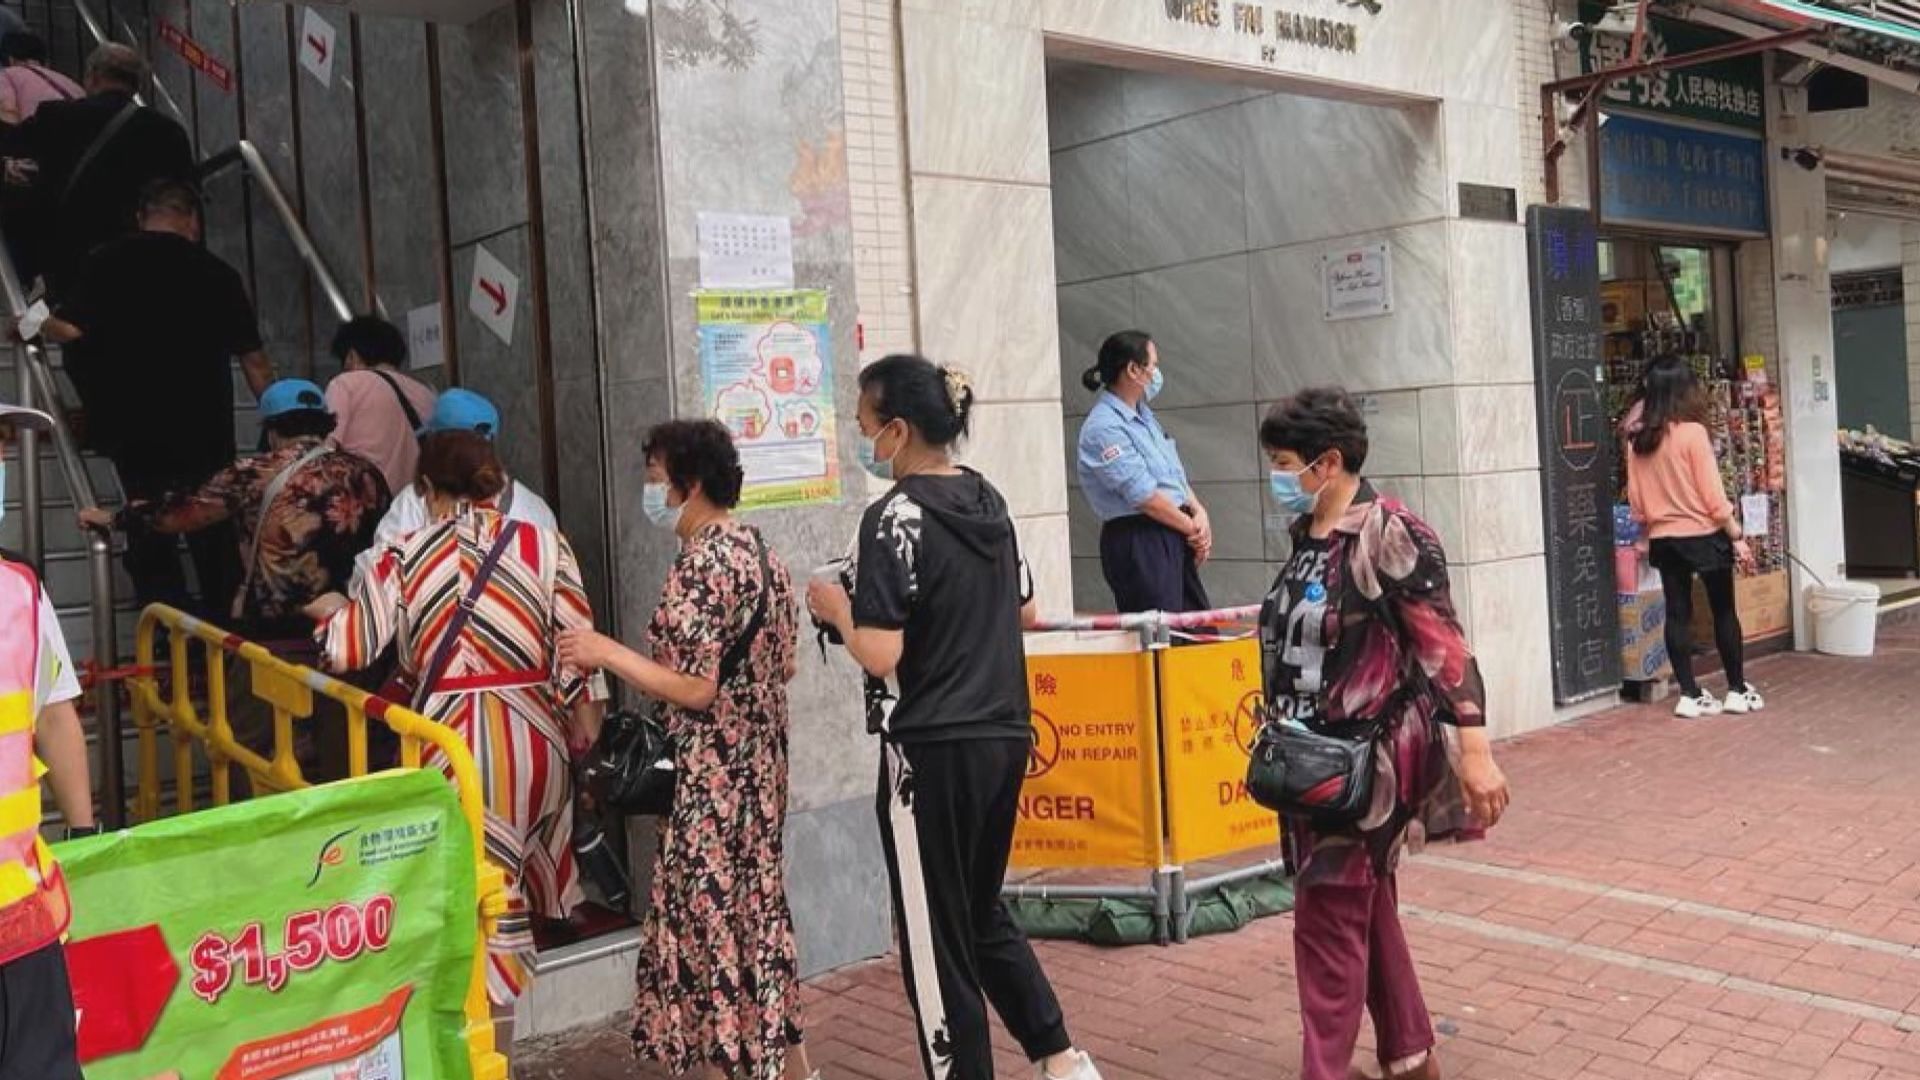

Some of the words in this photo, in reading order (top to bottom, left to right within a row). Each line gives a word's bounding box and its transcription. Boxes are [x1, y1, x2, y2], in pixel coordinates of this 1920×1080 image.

[1275, 10, 1357, 54] MANSION
[1035, 673, 1057, 696] 險
[1059, 723, 1081, 736] NO
[1085, 722, 1136, 736] ENTRY
[1061, 748, 1077, 761] IN
[1083, 746, 1139, 761] REPAIR
[191, 893, 395, 1003] $1,500
